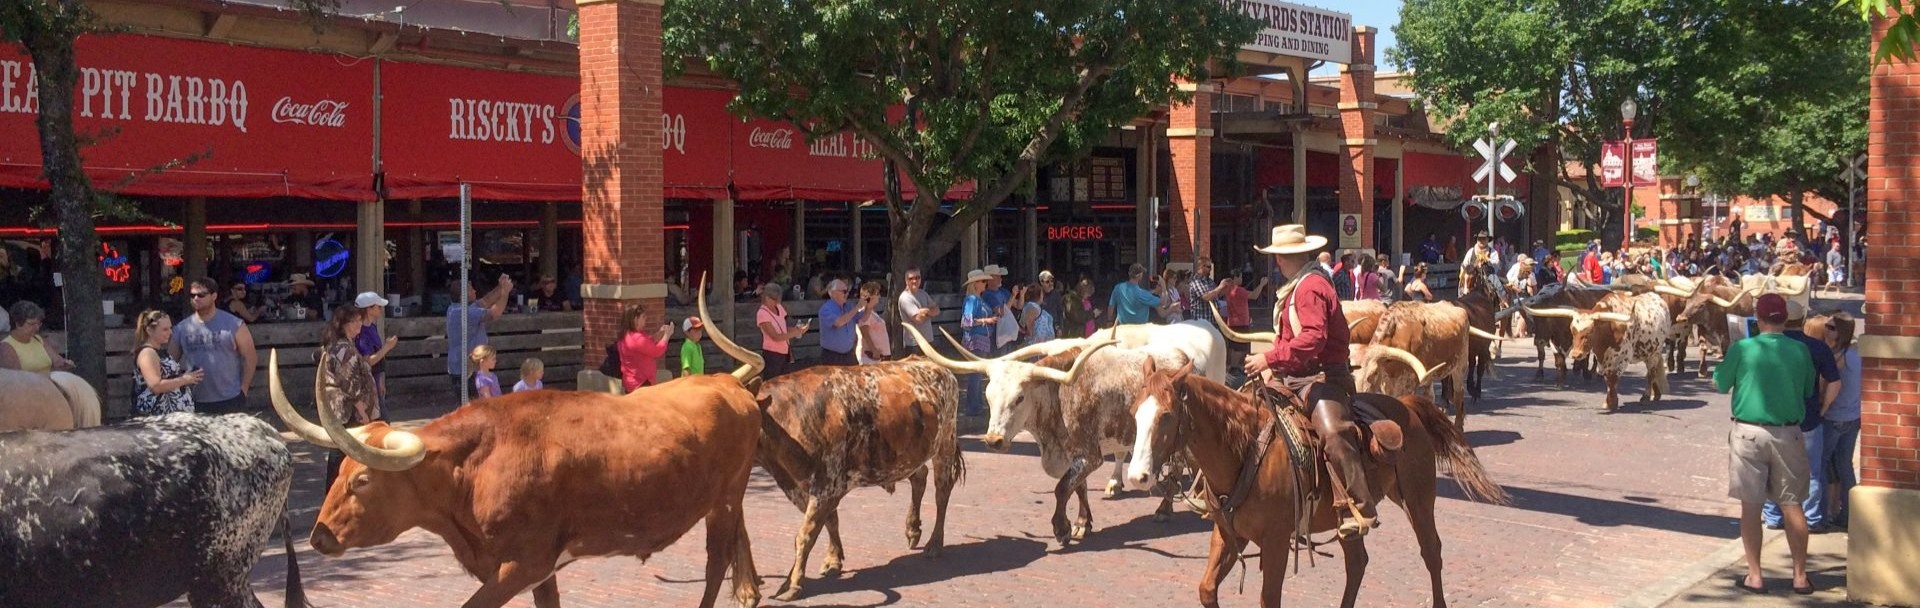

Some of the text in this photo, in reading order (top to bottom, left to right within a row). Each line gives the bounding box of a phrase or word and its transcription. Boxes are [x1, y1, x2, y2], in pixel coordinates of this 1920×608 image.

[1300, 10, 1349, 42] STATION
[1281, 37, 1300, 51] AND
[1301, 40, 1329, 56] DINING
[0, 60, 39, 113] EA
[81, 67, 137, 120] PIT
[271, 96, 349, 127] Coca-Cola
[449, 98, 555, 144] RISCKY'S
[749, 126, 793, 149] Coca-Cola
[1048, 225, 1103, 240] BURGERS
